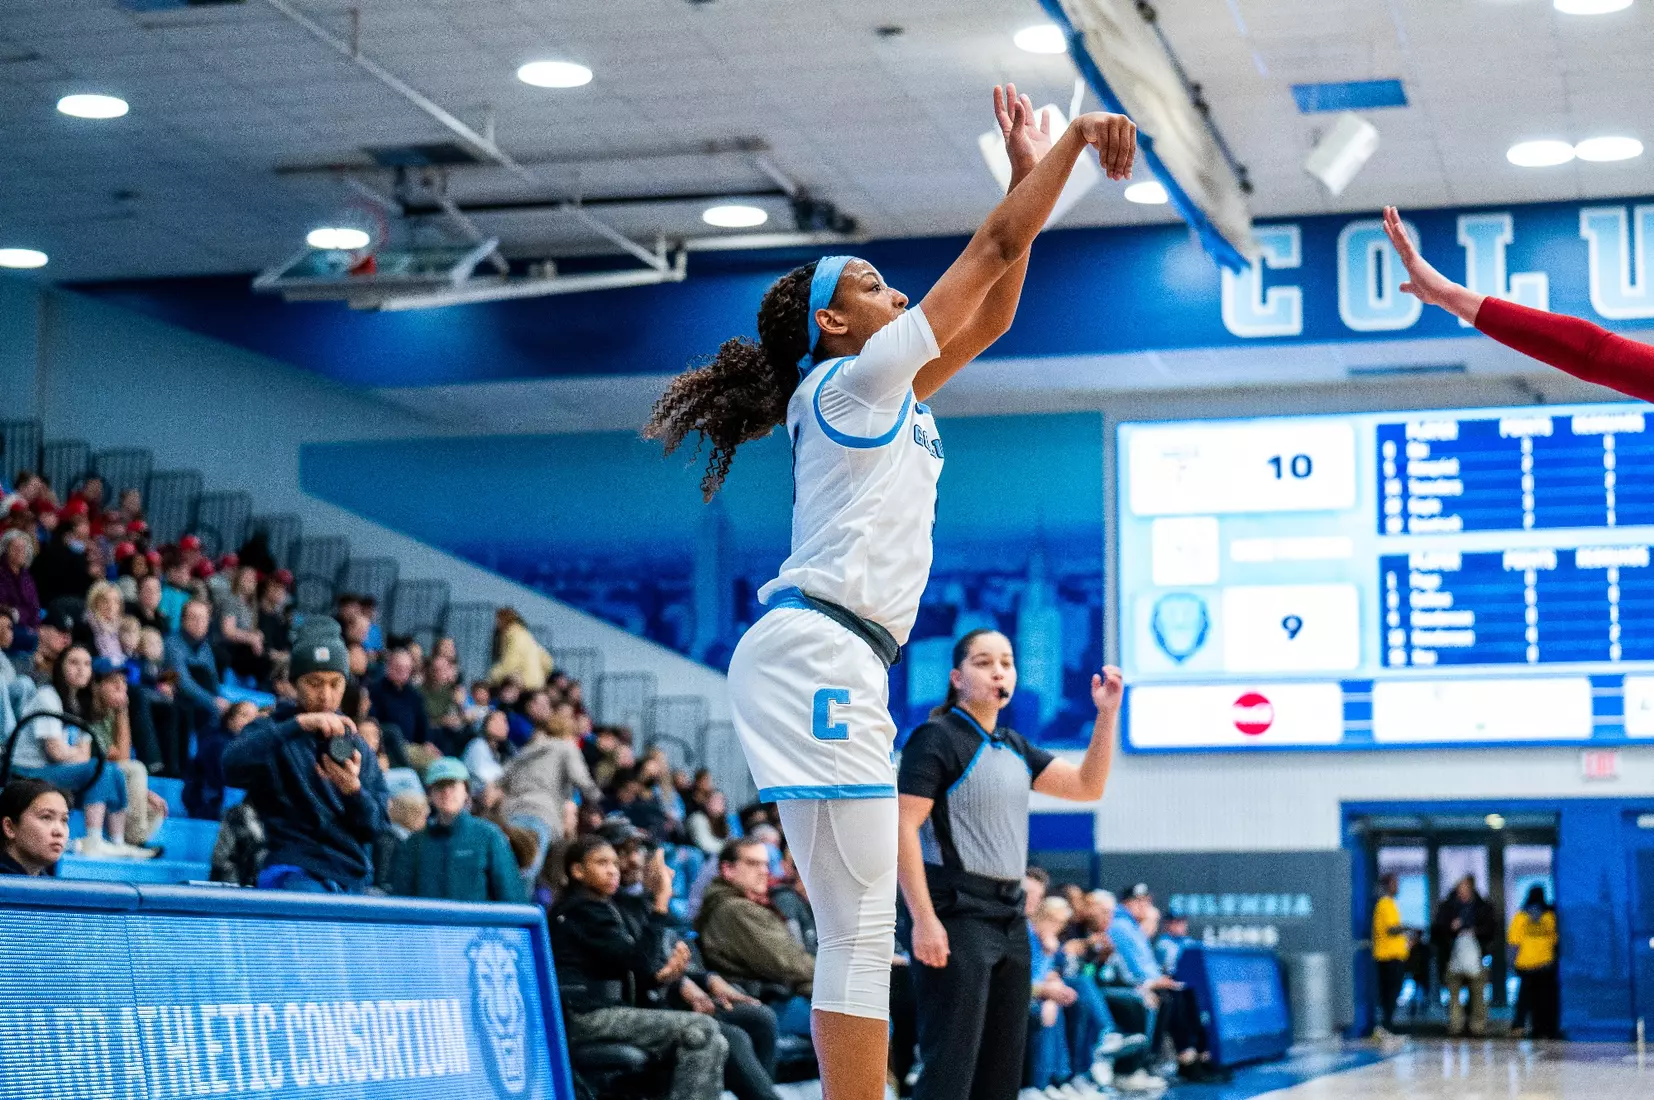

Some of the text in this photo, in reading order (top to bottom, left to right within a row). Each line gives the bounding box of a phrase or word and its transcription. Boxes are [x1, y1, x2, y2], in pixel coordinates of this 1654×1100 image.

[1221, 206, 1654, 337] COLU
[1267, 454, 1312, 480] 10
[1281, 614, 1303, 640] 9
[812, 687, 850, 741] C
[121, 1002, 283, 1100] ATHLETIC
[284, 999, 470, 1086] CONSORTIUM
